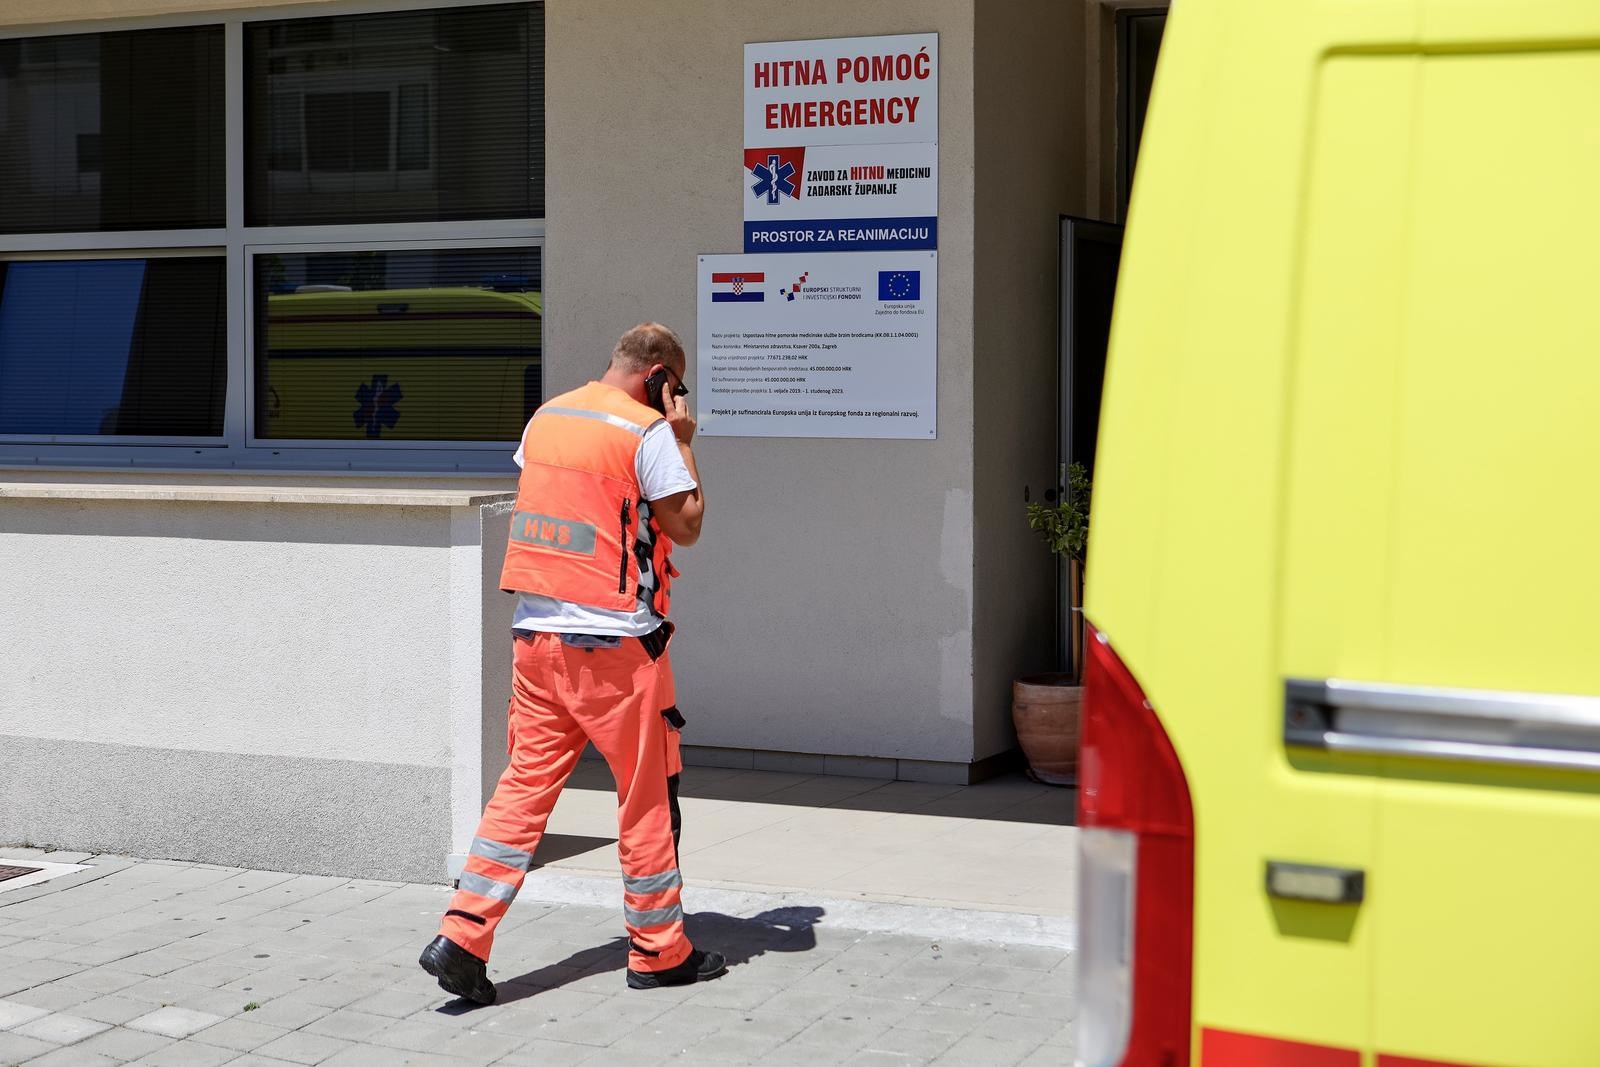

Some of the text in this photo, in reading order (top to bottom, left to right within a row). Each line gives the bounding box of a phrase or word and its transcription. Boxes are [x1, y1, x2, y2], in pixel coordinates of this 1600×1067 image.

[754, 46, 930, 88] HITNA POMOĆ
[765, 97, 920, 129] EMERGENCY
[807, 166, 930, 182] ZAVOD ZA HITNU MEDICINU
[807, 183, 897, 196] ZADARSKE ŽUPANIJE
[752, 228, 928, 242] PROSTOR ZA REANIMACIJU
[524, 518, 571, 544] HMS
